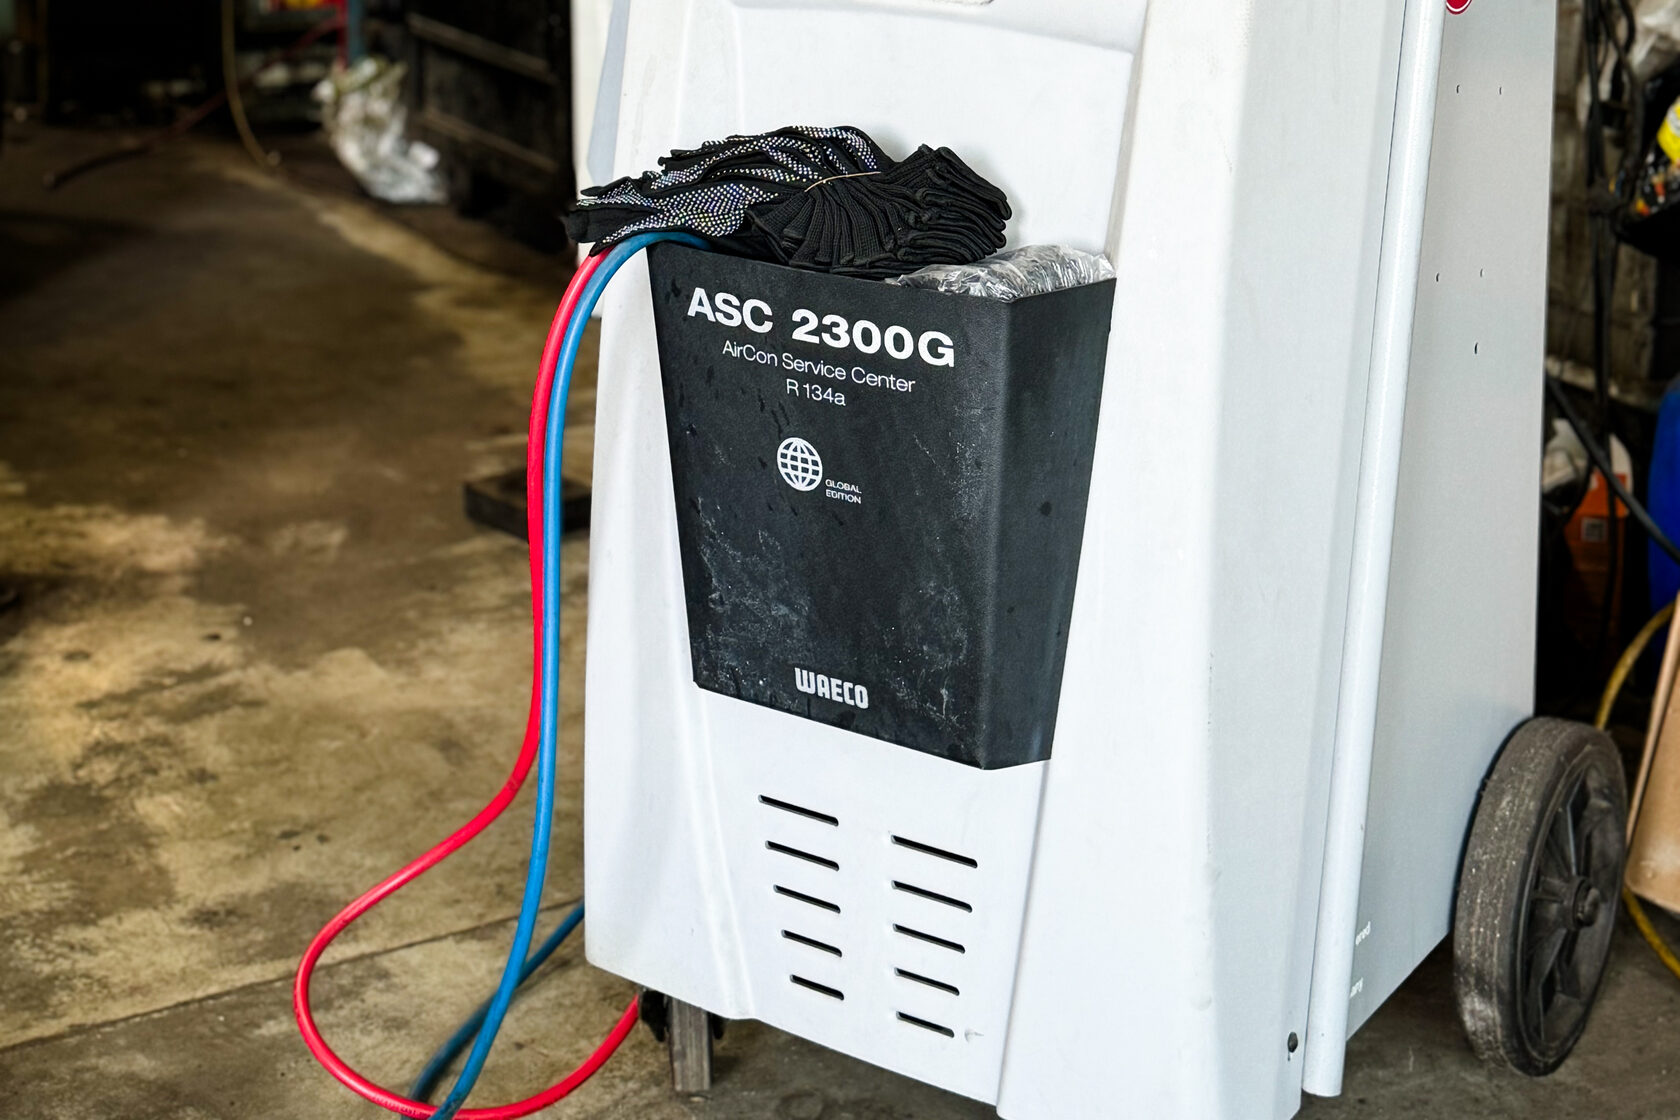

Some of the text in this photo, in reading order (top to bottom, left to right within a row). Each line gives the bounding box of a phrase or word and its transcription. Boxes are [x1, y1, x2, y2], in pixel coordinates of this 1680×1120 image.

[687, 286, 955, 368] ASC 2300G
[721, 339, 916, 393] AirCon Service Center
[786, 378, 847, 407] R 134a
[825, 478, 863, 494] GLOBAL
[825, 489, 862, 505] EDITION
[794, 667, 869, 710] WAECO
